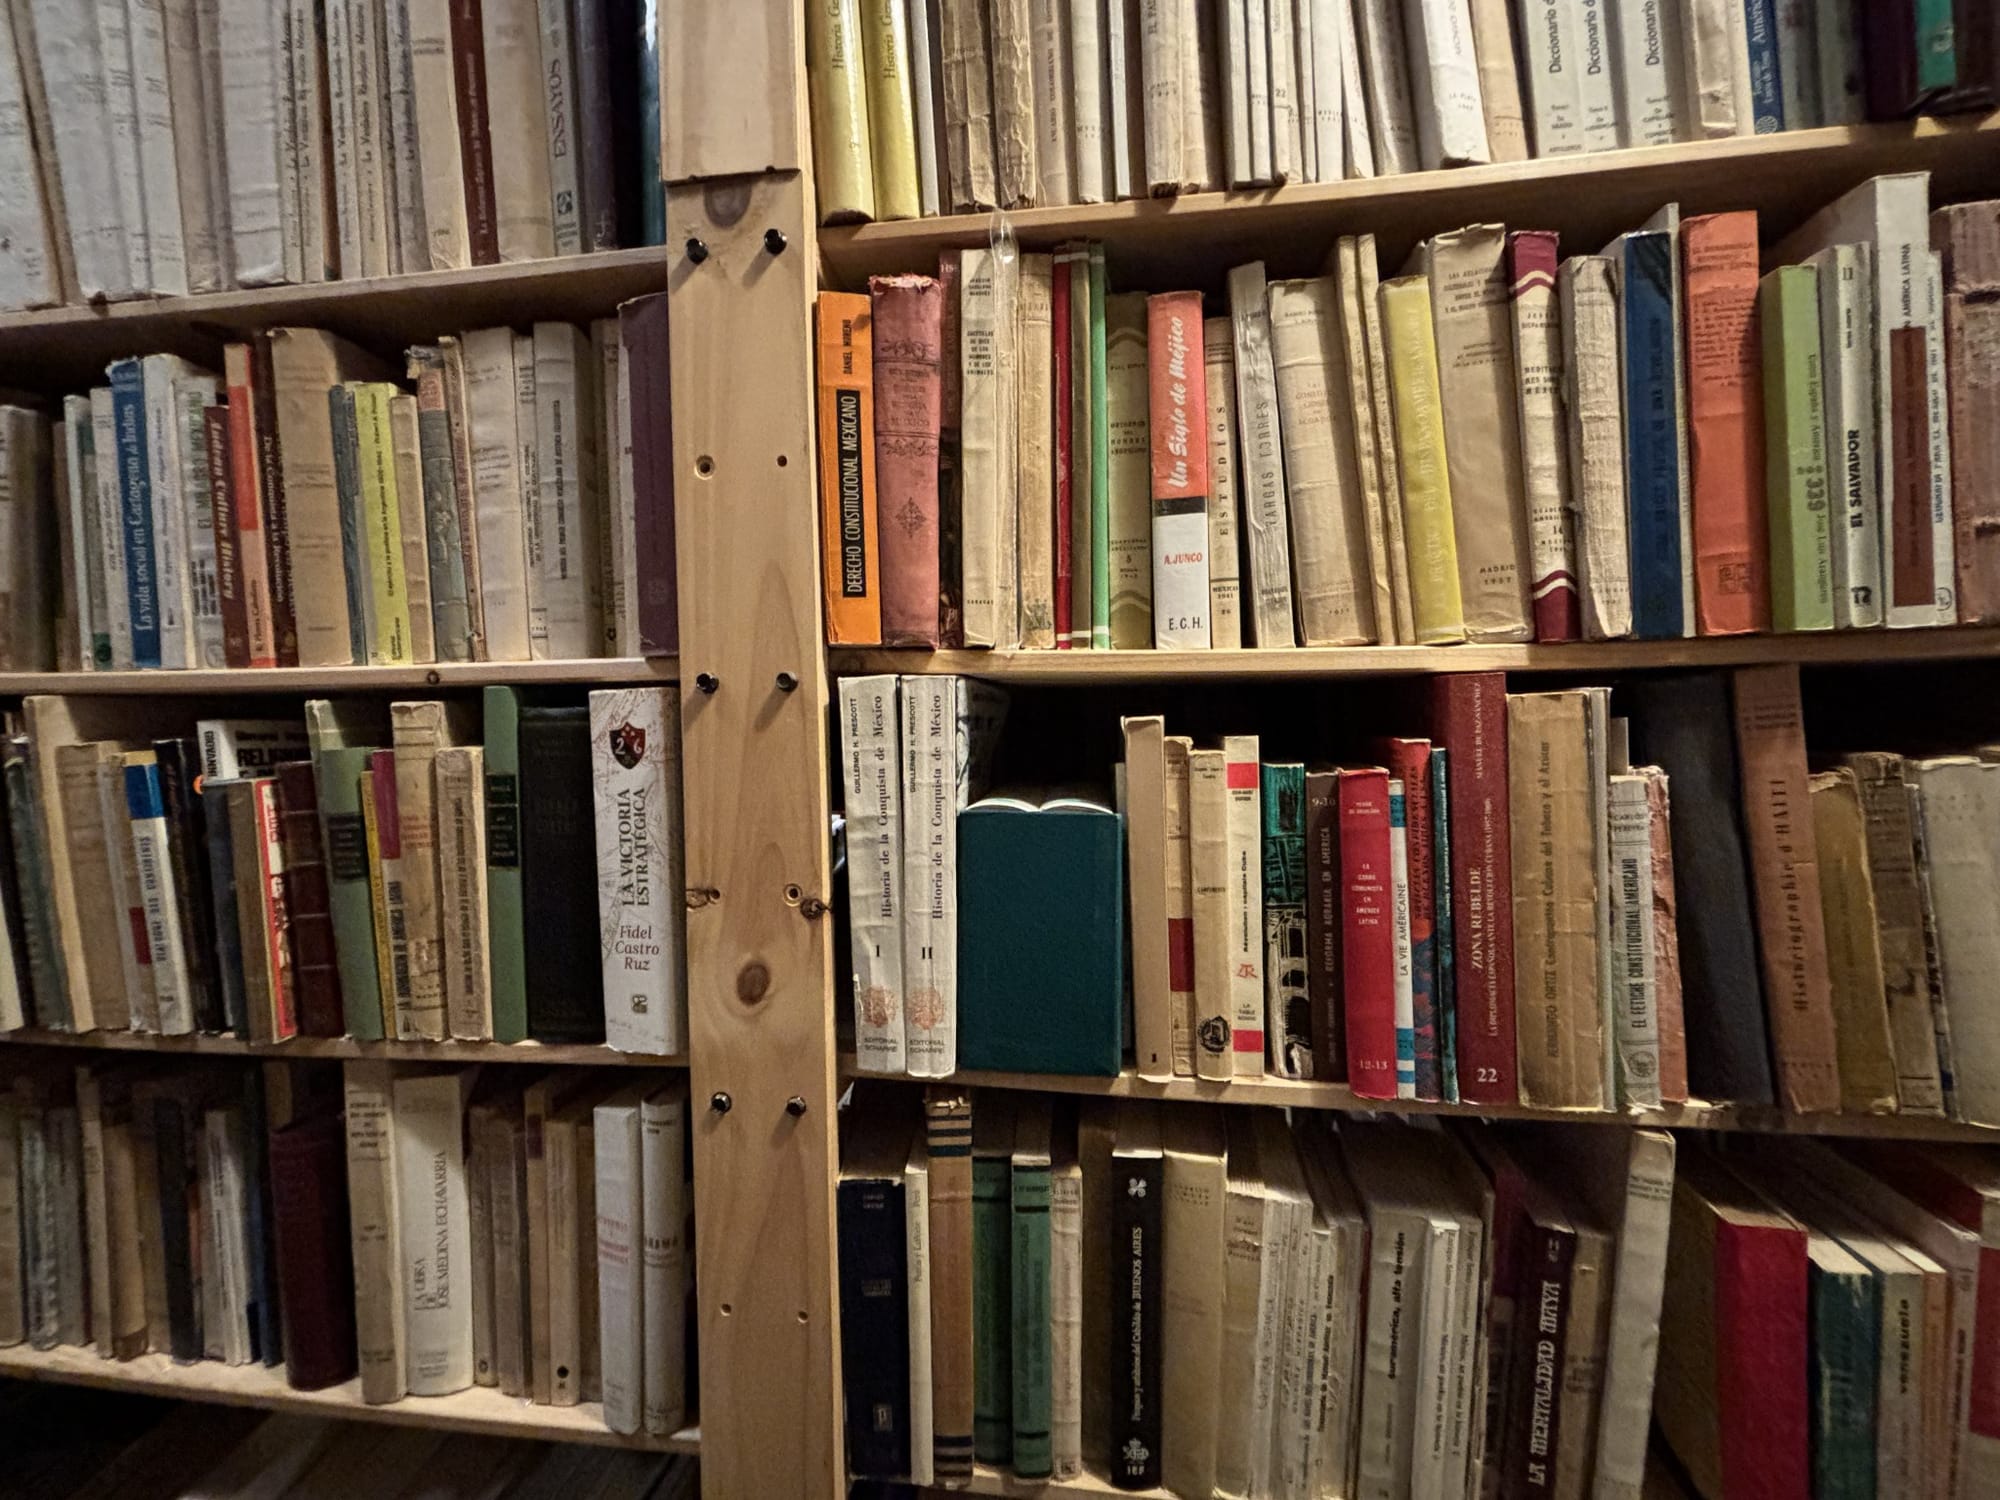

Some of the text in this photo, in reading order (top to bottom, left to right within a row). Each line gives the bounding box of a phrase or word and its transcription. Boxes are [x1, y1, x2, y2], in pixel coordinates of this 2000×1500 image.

[831, 24, 845, 69] Historia
[882, 34, 895, 78] Historia
[1546, 9, 1562, 74] Diccionario
[1587, 10, 1602, 75] Diccionario
[1645, 1, 1661, 66] Diccionario
[548, 59, 567, 158] ENSAYOS
[1900, 243, 1913, 317] AMERICA LATINA
[841, 318, 853, 375] DANIEL MORENO
[1165, 315, 1188, 380] Méjico
[1169, 382, 1186, 406] de
[121, 404, 137, 443] Indias
[1167, 408, 1192, 457] Siglo
[1256, 400, 1273, 458] TORRES
[126, 457, 147, 525] Cartagena
[265, 466, 278, 521] Conquista
[840, 395, 863, 593] DERECHO CONSTITUCIONAL MEXICANO
[1167, 460, 1188, 488] Un
[1806, 478, 1826, 512] 339
[1846, 429, 1864, 528] EL SALVADOR
[131, 528, 145, 544] en
[132, 546, 149, 583] social
[219, 540, 235, 599] History
[1479, 564, 1516, 574] MADRID
[134, 585, 151, 614] vida
[137, 614, 154, 631] La
[613, 738, 625, 756] 2
[848, 697, 862, 795] GUILLERMO H. PRESCOTT
[908, 694, 917, 793] GUILLERMO H. PRESCOTT
[869, 694, 893, 918] Historia de la Conquista de México
[929, 694, 947, 920] Historia de la Conquista de México
[617, 788, 636, 907] LA VICTORIA
[630, 786, 650, 907] ESTRATÉGICA
[1240, 850, 1248, 872] Cuba
[1319, 826, 1333, 866] AMERICA
[619, 924, 654, 939] Fidel
[1394, 883, 1409, 977] LA VIE AMÉRICAINE
[1467, 866, 1484, 970] ZONA REBELDE
[1621, 857, 1648, 1029] EL FETICHE CONSTITUCIONAL AMERICANO
[1781, 862, 1810, 1012] Historiographie
[613, 940, 660, 956] Castro
[623, 957, 651, 971] Ruz
[874, 944, 881, 958] I
[920, 946, 933, 960] II
[1541, 969, 1557, 1001] ORTIZ
[1542, 1004, 1560, 1058] FERNANDO
[1476, 1067, 1498, 1083] 22
[435, 1228, 449, 1280] MEDINA
[1130, 1226, 1143, 1257] AIRES
[1392, 1231, 1406, 1275] tensión
[1131, 1259, 1143, 1300] BUENOS
[1898, 1299, 1911, 1396] venezuela
[1527, 1279, 1562, 1487] LA MENTALIDAD MAYA
